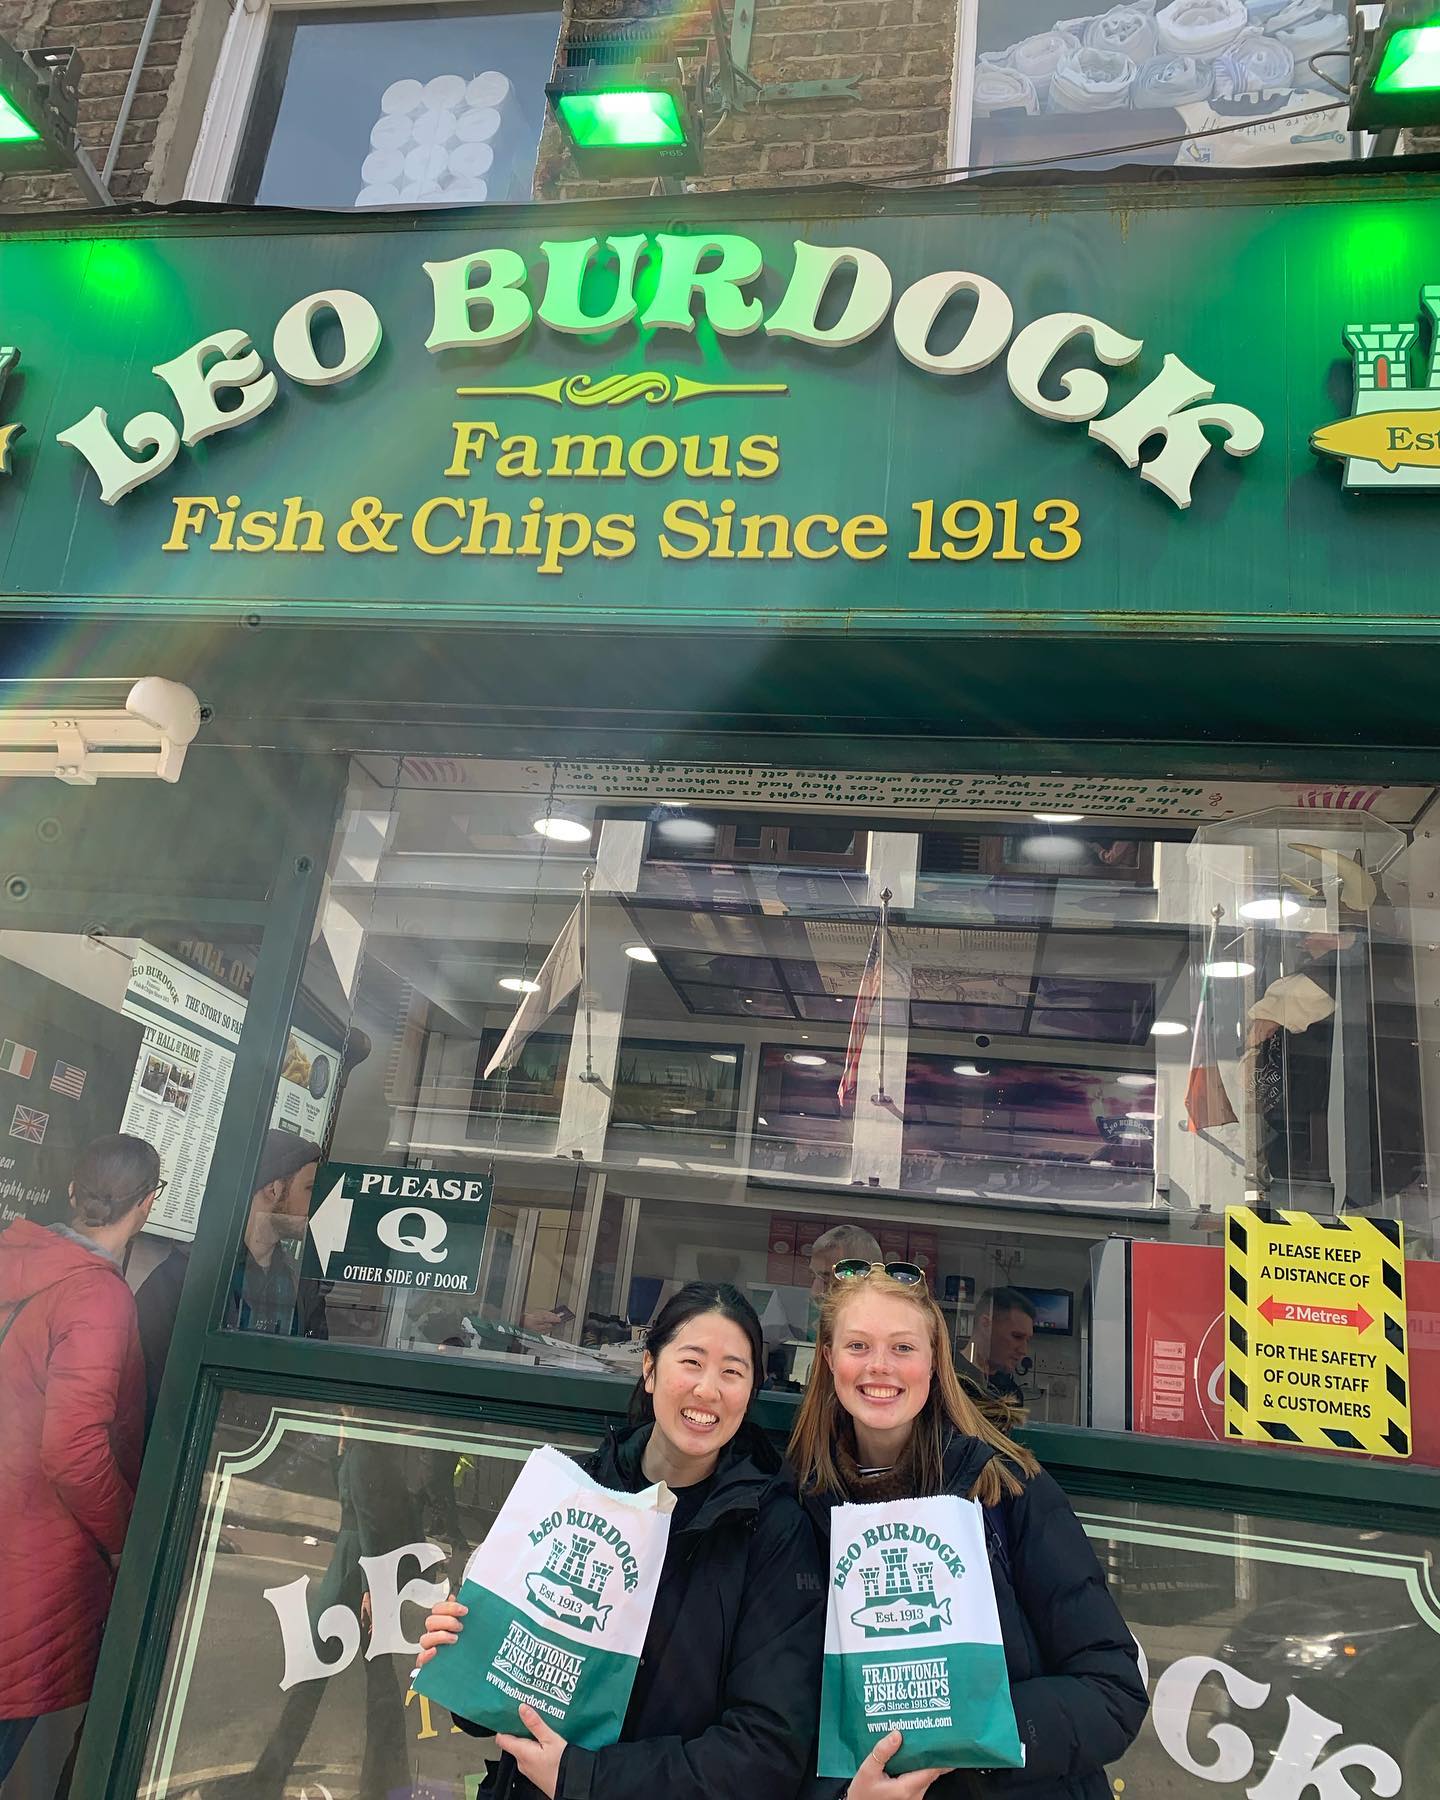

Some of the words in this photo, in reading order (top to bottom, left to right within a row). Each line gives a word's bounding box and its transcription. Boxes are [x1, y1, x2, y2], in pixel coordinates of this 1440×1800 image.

[56, 289, 383, 506] LEO
[421, 232, 1265, 510] BURDOCK
[443, 420, 781, 479] Famous
[161, 494, 327, 553] Fish
[335, 499, 402, 555] &
[410, 494, 638, 575] Chips
[657, 498, 889, 561] Since
[907, 497, 1082, 562] 1913
[667, 776, 720, 786] where
[756, 780, 793, 789] had
[800, 781, 842, 791] they
[910, 776, 964, 787] Quay
[970, 778, 1031, 789] Wood
[1071, 783, 1149, 794] landed
[655, 786, 736, 796] everyone
[768, 790, 818, 800] eight
[824, 792, 886, 802] eighty
[890, 787, 958, 796] Dublin
[994, 790, 1047, 798] came
[1054, 792, 1137, 804] Vikings
[1156, 785, 1203, 796] they
[892, 796, 931, 804] and
[937, 798, 1022, 808] hundred
[1029, 801, 1075, 809] nine
[1081, 804, 1128, 812] year
[1145, 797, 1179, 806] the
[1136, 806, 1169, 815] the
[1177, 808, 1204, 817] In
[132, 965, 144, 977] EO
[185, 993, 201, 1013] THE
[200, 1001, 223, 1024] STORY
[222, 1013, 232, 1029] SO
[157, 1030, 177, 1052] HALL
[180, 1042, 201, 1063] FAME
[359, 1173, 483, 1202] PLEASE
[25, 1186, 51, 1206] eight
[376, 1206, 448, 1264] Q
[1268, 1242, 1322, 1261] PLEASE
[1324, 1247, 1362, 1264] KEEP
[343, 1264, 382, 1283] OTHER
[384, 1268, 412, 1285] SIDE
[416, 1271, 432, 1287] OF
[433, 1273, 468, 1290] DOOR
[1260, 1265, 1272, 1279] A
[1274, 1266, 1346, 1287] DISTANCE
[1349, 1273, 1371, 1289] OF
[1284, 1306, 1295, 1320] 2
[1295, 1306, 1349, 1325] Metres
[1255, 1342, 1287, 1359] FOR
[1288, 1346, 1319, 1362] THE
[1321, 1350, 1377, 1369] SAFETY
[1263, 1369, 1285, 1383] OF
[1287, 1371, 1323, 1388] OUR
[1324, 1374, 1370, 1393] STAFF
[1263, 1394, 1275, 1408] &
[1277, 1395, 1371, 1419] CUSTOMERS
[527, 1511, 563, 1547] LEO
[566, 1508, 640, 1592] BURDOCK
[833, 1543, 862, 1590] LEO
[862, 1522, 966, 1579] BURDOCK
[538, 1583, 556, 1603] Est.
[557, 1595, 583, 1614] 1913
[875, 1611, 898, 1623] Est.
[899, 1608, 924, 1622] 1913
[506, 1623, 582, 1676] TRADITIONAL
[511, 1666, 531, 1684] Since
[531, 1678, 550, 1692] 1913
[862, 1661, 949, 1685] TRADITIONAL
[485, 1671, 566, 1720] www.leoburdock.com
[887, 1701, 910, 1711] Since
[911, 1699, 929, 1709] 1913
[867, 1716, 953, 1733] www.leoburdock.com
